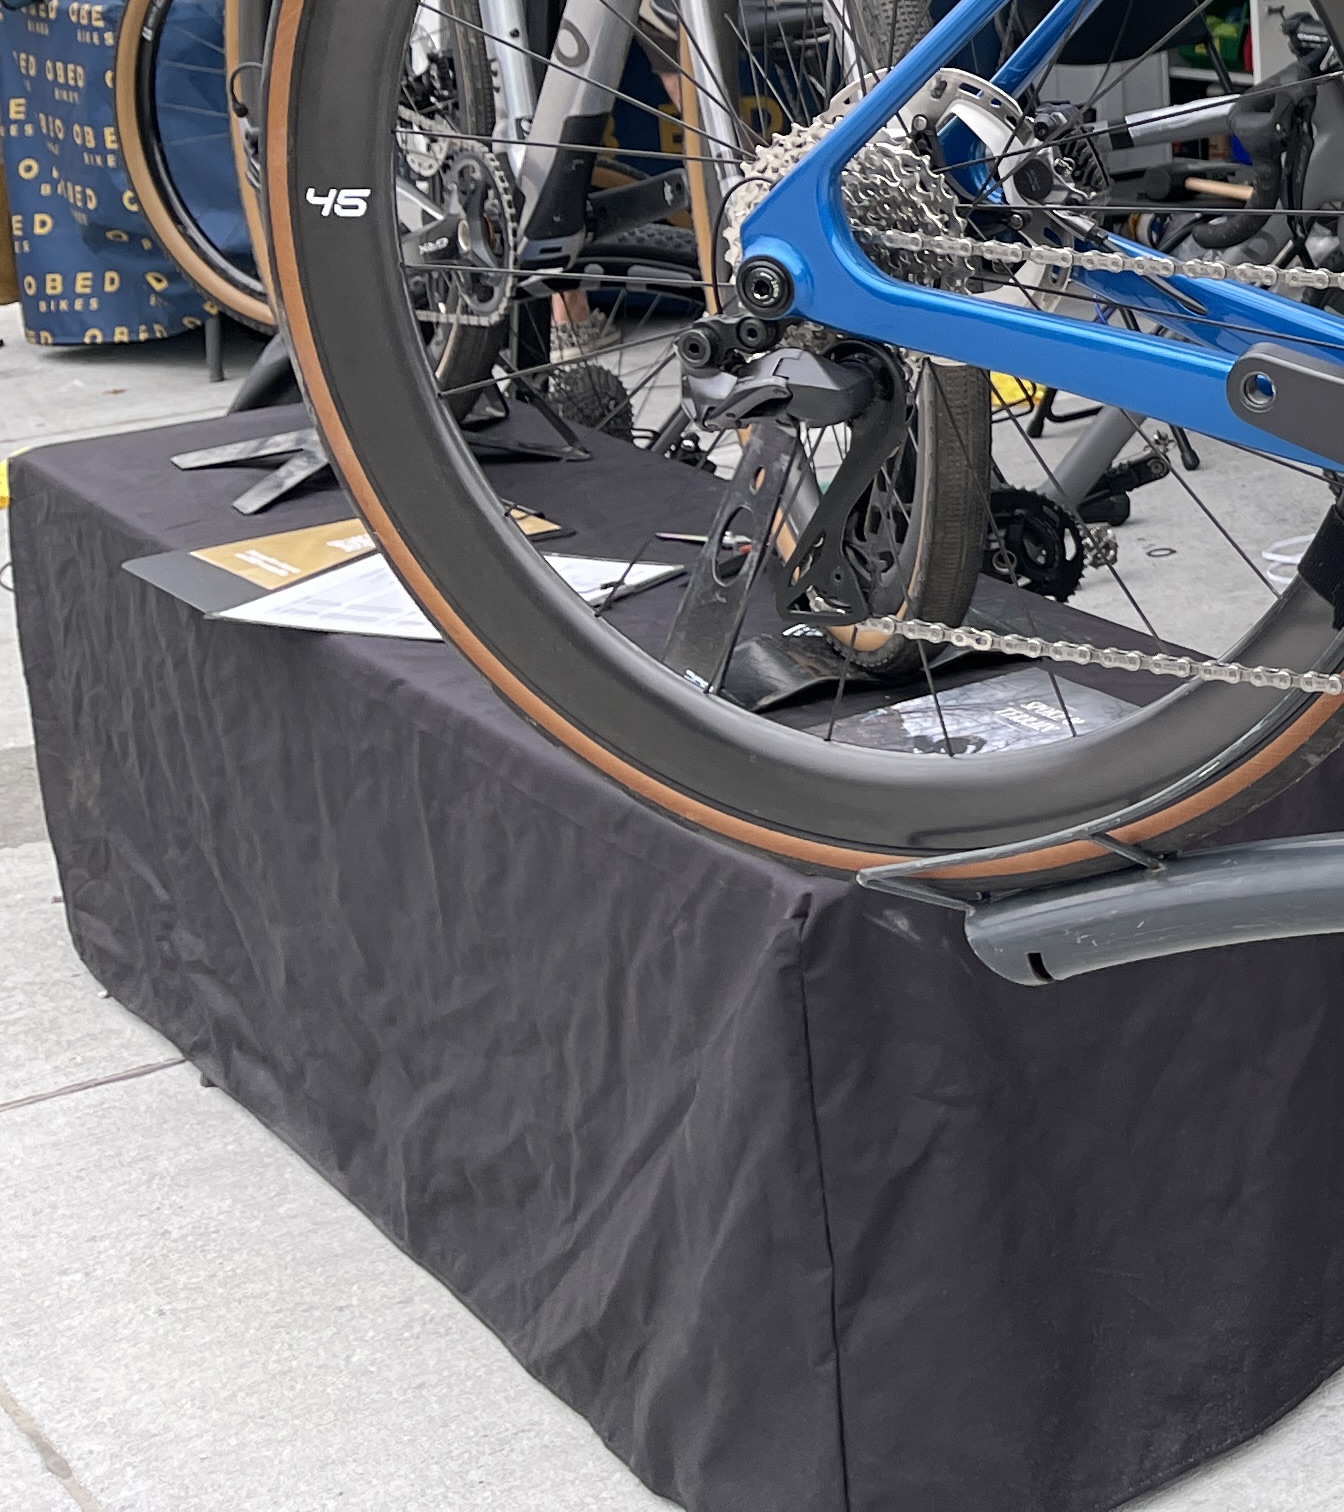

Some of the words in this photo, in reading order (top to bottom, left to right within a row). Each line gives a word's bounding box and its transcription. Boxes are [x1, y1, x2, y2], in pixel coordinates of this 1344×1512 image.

[305, 187, 372, 218] 45
[24, 270, 120, 293] OBED
[38, 297, 99, 312] BIKES
